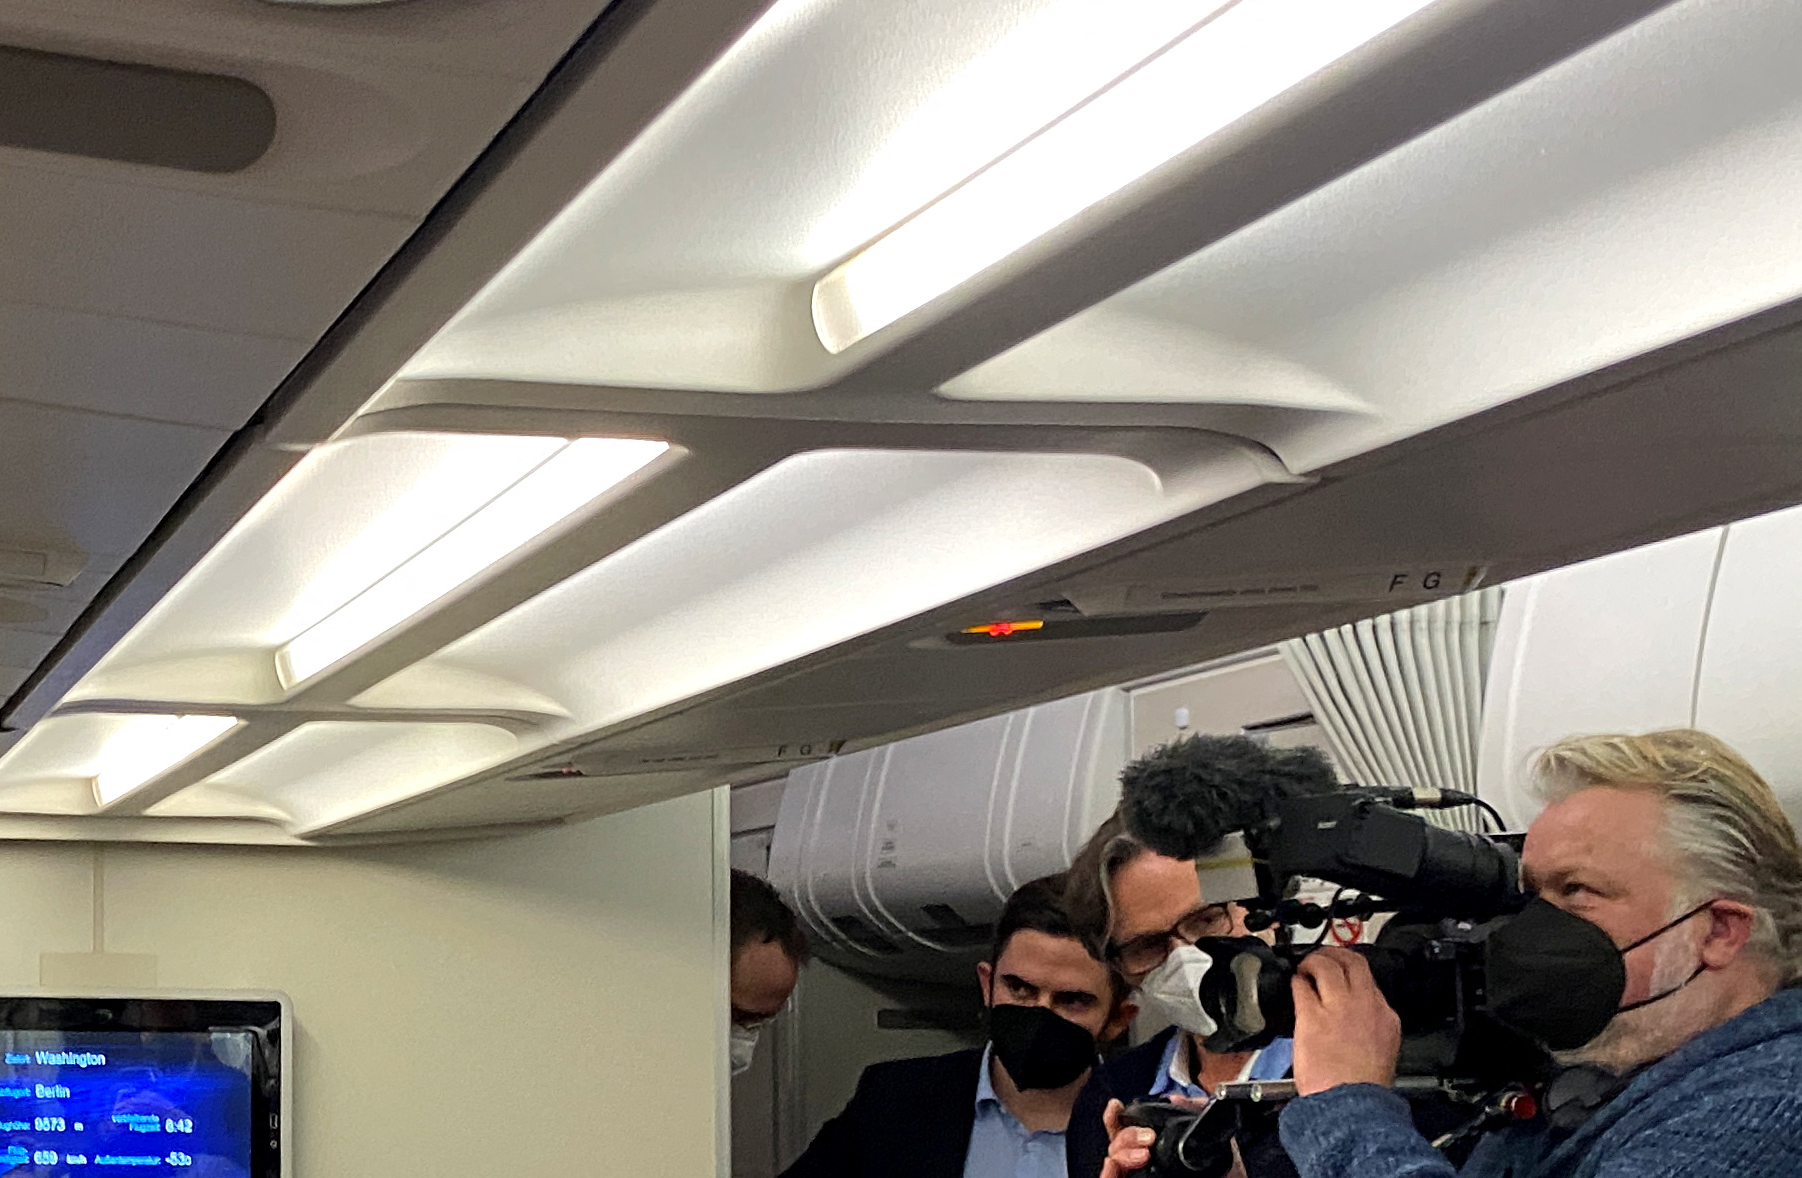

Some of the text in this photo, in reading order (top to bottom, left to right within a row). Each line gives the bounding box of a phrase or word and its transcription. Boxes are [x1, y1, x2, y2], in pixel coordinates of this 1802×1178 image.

[1388, 571, 1441, 592] F G
[35, 1051, 106, 1068] Washington
[35, 1084, 71, 1098] Berlin
